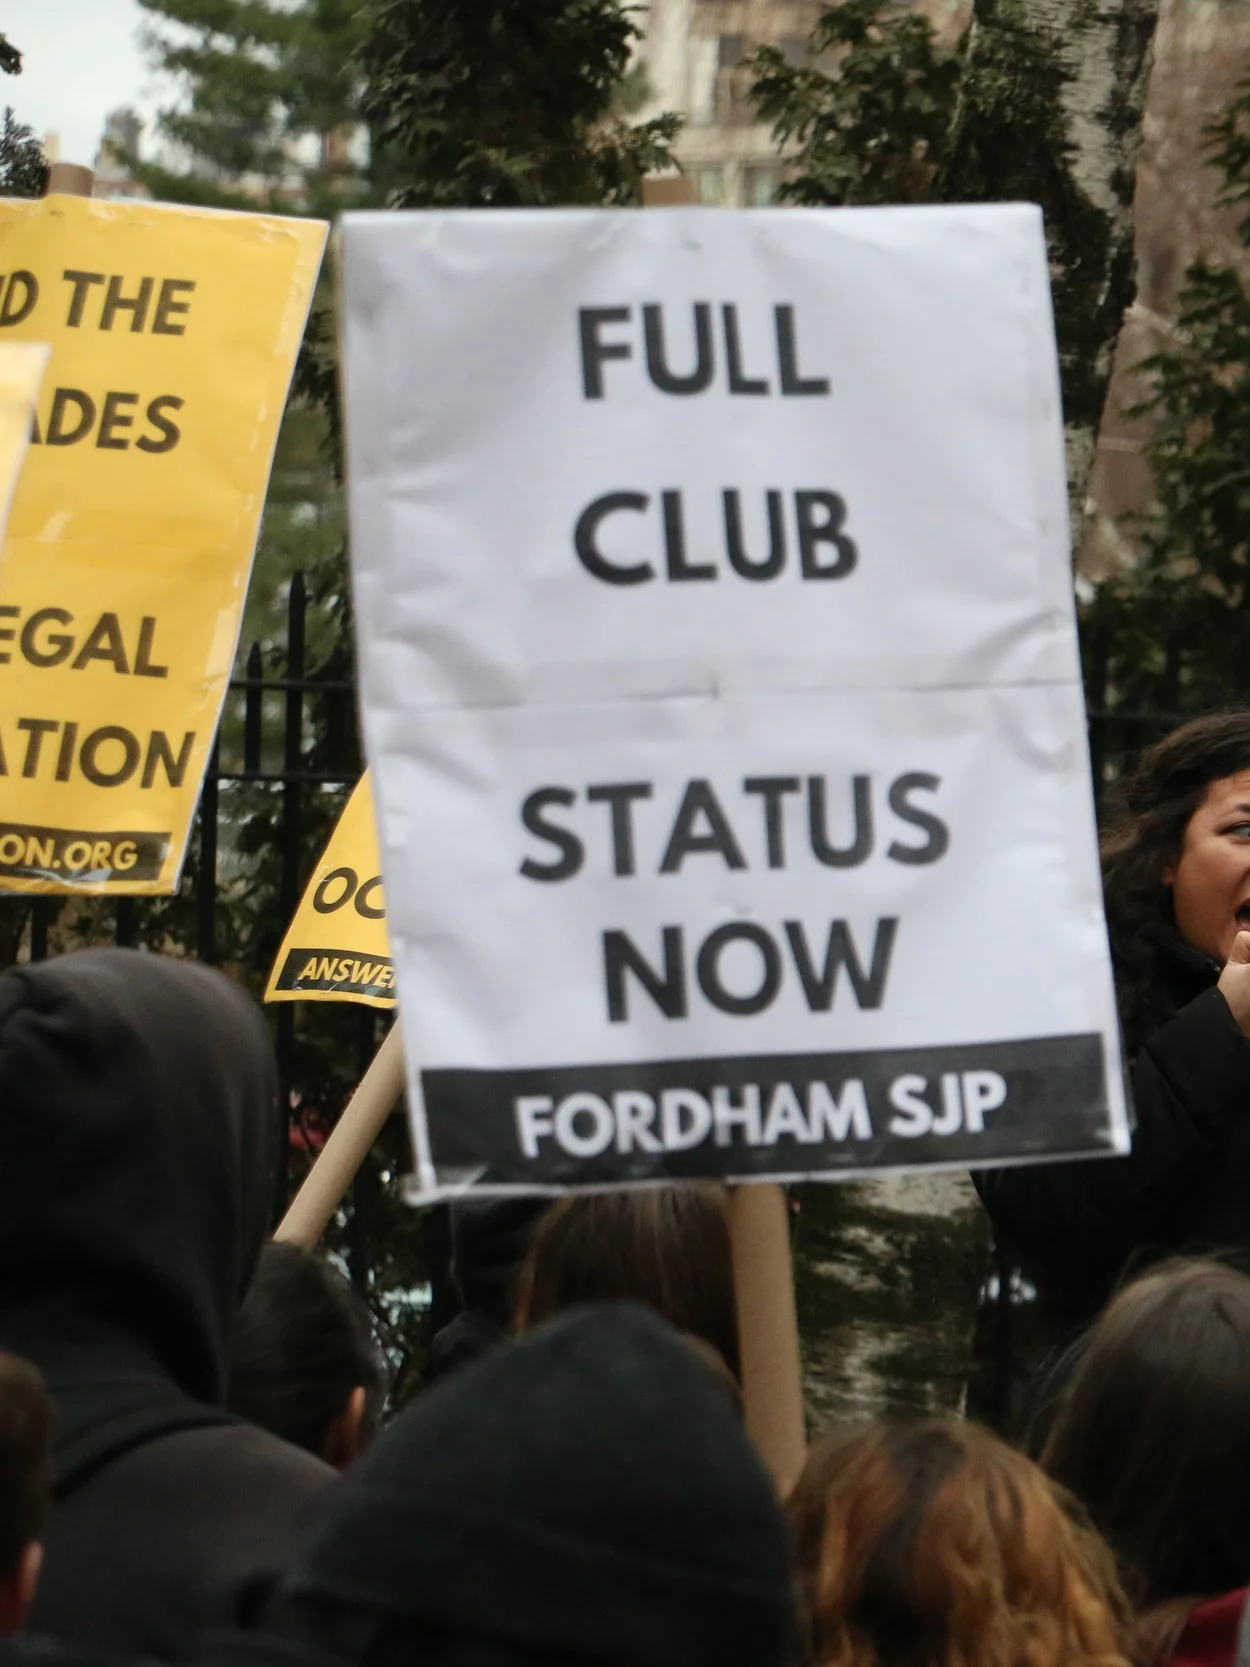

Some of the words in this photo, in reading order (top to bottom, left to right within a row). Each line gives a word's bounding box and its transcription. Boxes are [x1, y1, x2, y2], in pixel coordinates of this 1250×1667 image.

[62, 269, 196, 336] THE
[578, 302, 831, 400] FULL
[29, 386, 186, 454] DES
[573, 489, 857, 586] CLUB
[0, 717, 196, 789] TION
[519, 772, 949, 883] STATUS
[298, 956, 397, 990] ANSWE
[602, 916, 898, 1023] NOW
[515, 1078, 873, 1158] FORDHAM
[888, 1071, 1007, 1138] SJP
